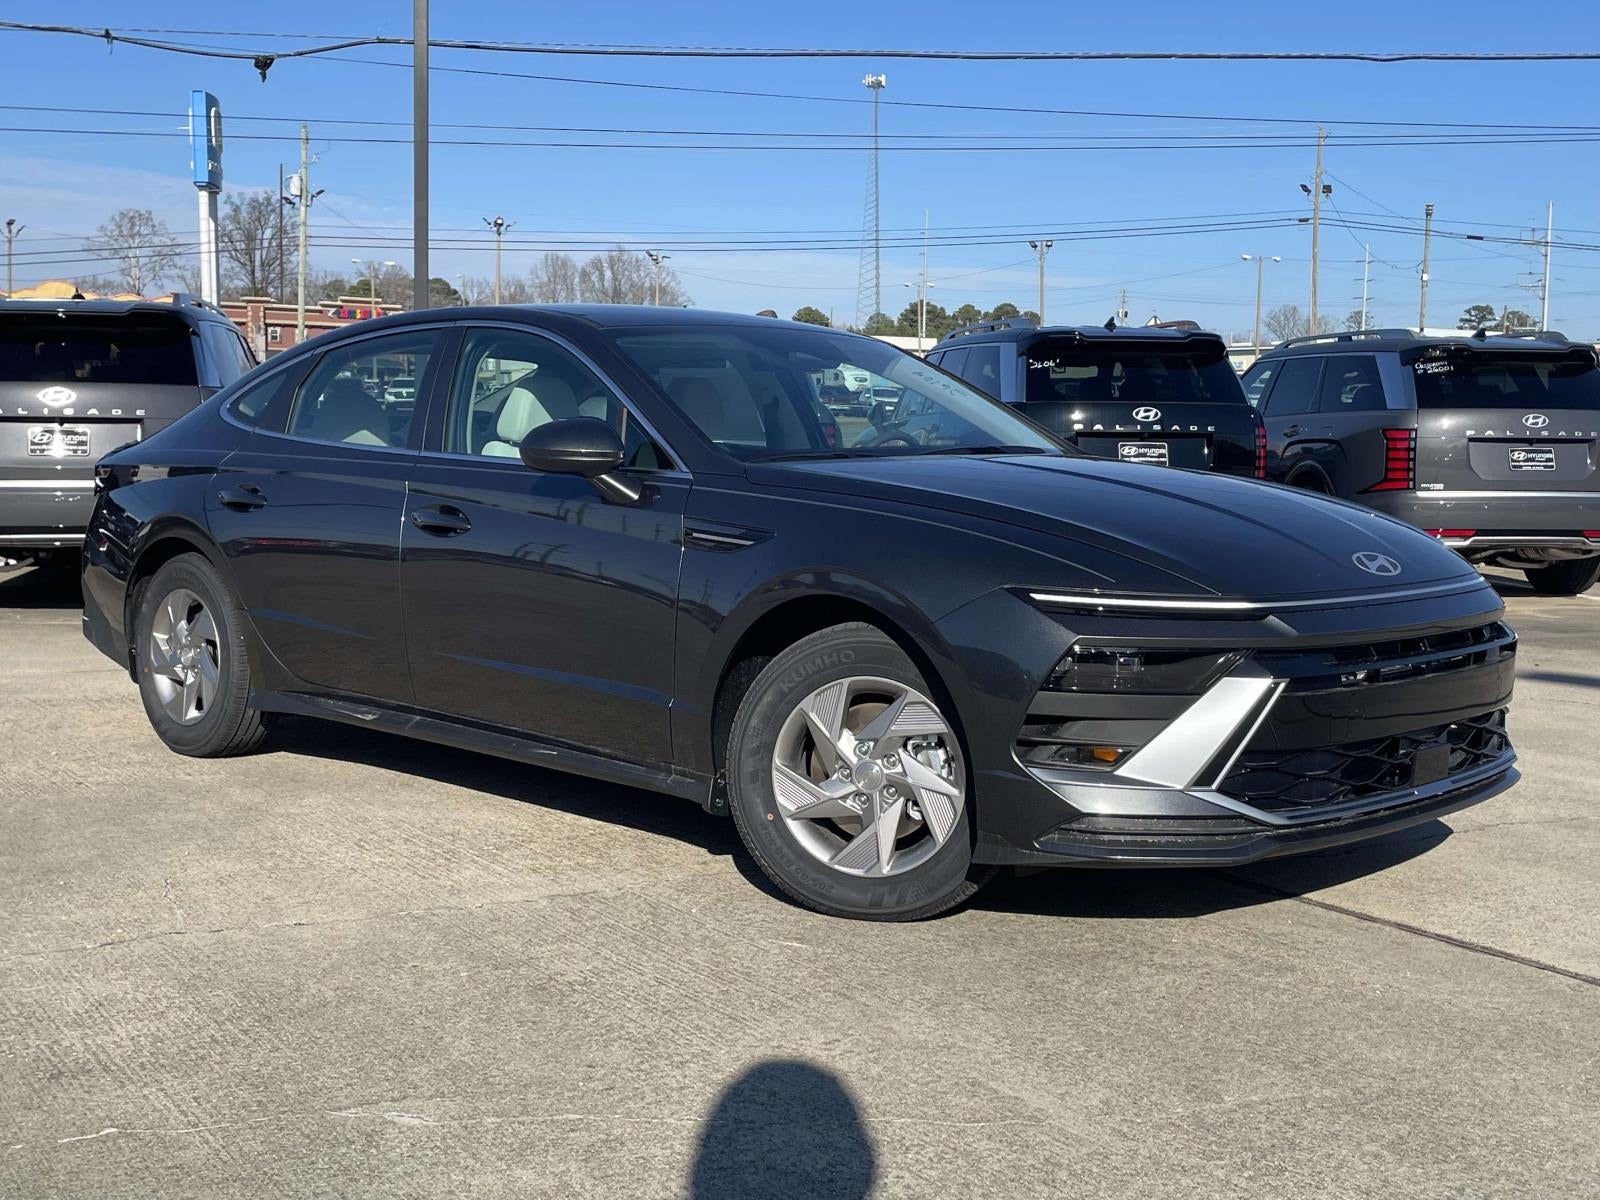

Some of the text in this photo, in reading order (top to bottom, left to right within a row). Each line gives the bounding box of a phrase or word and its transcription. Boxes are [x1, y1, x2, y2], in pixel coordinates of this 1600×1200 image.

[0, 407, 146, 416] LISADE
[1073, 423, 1216, 432] PALISADE
[1465, 429, 1598, 437] PALISADE
[779, 650, 856, 693] KUMHO
